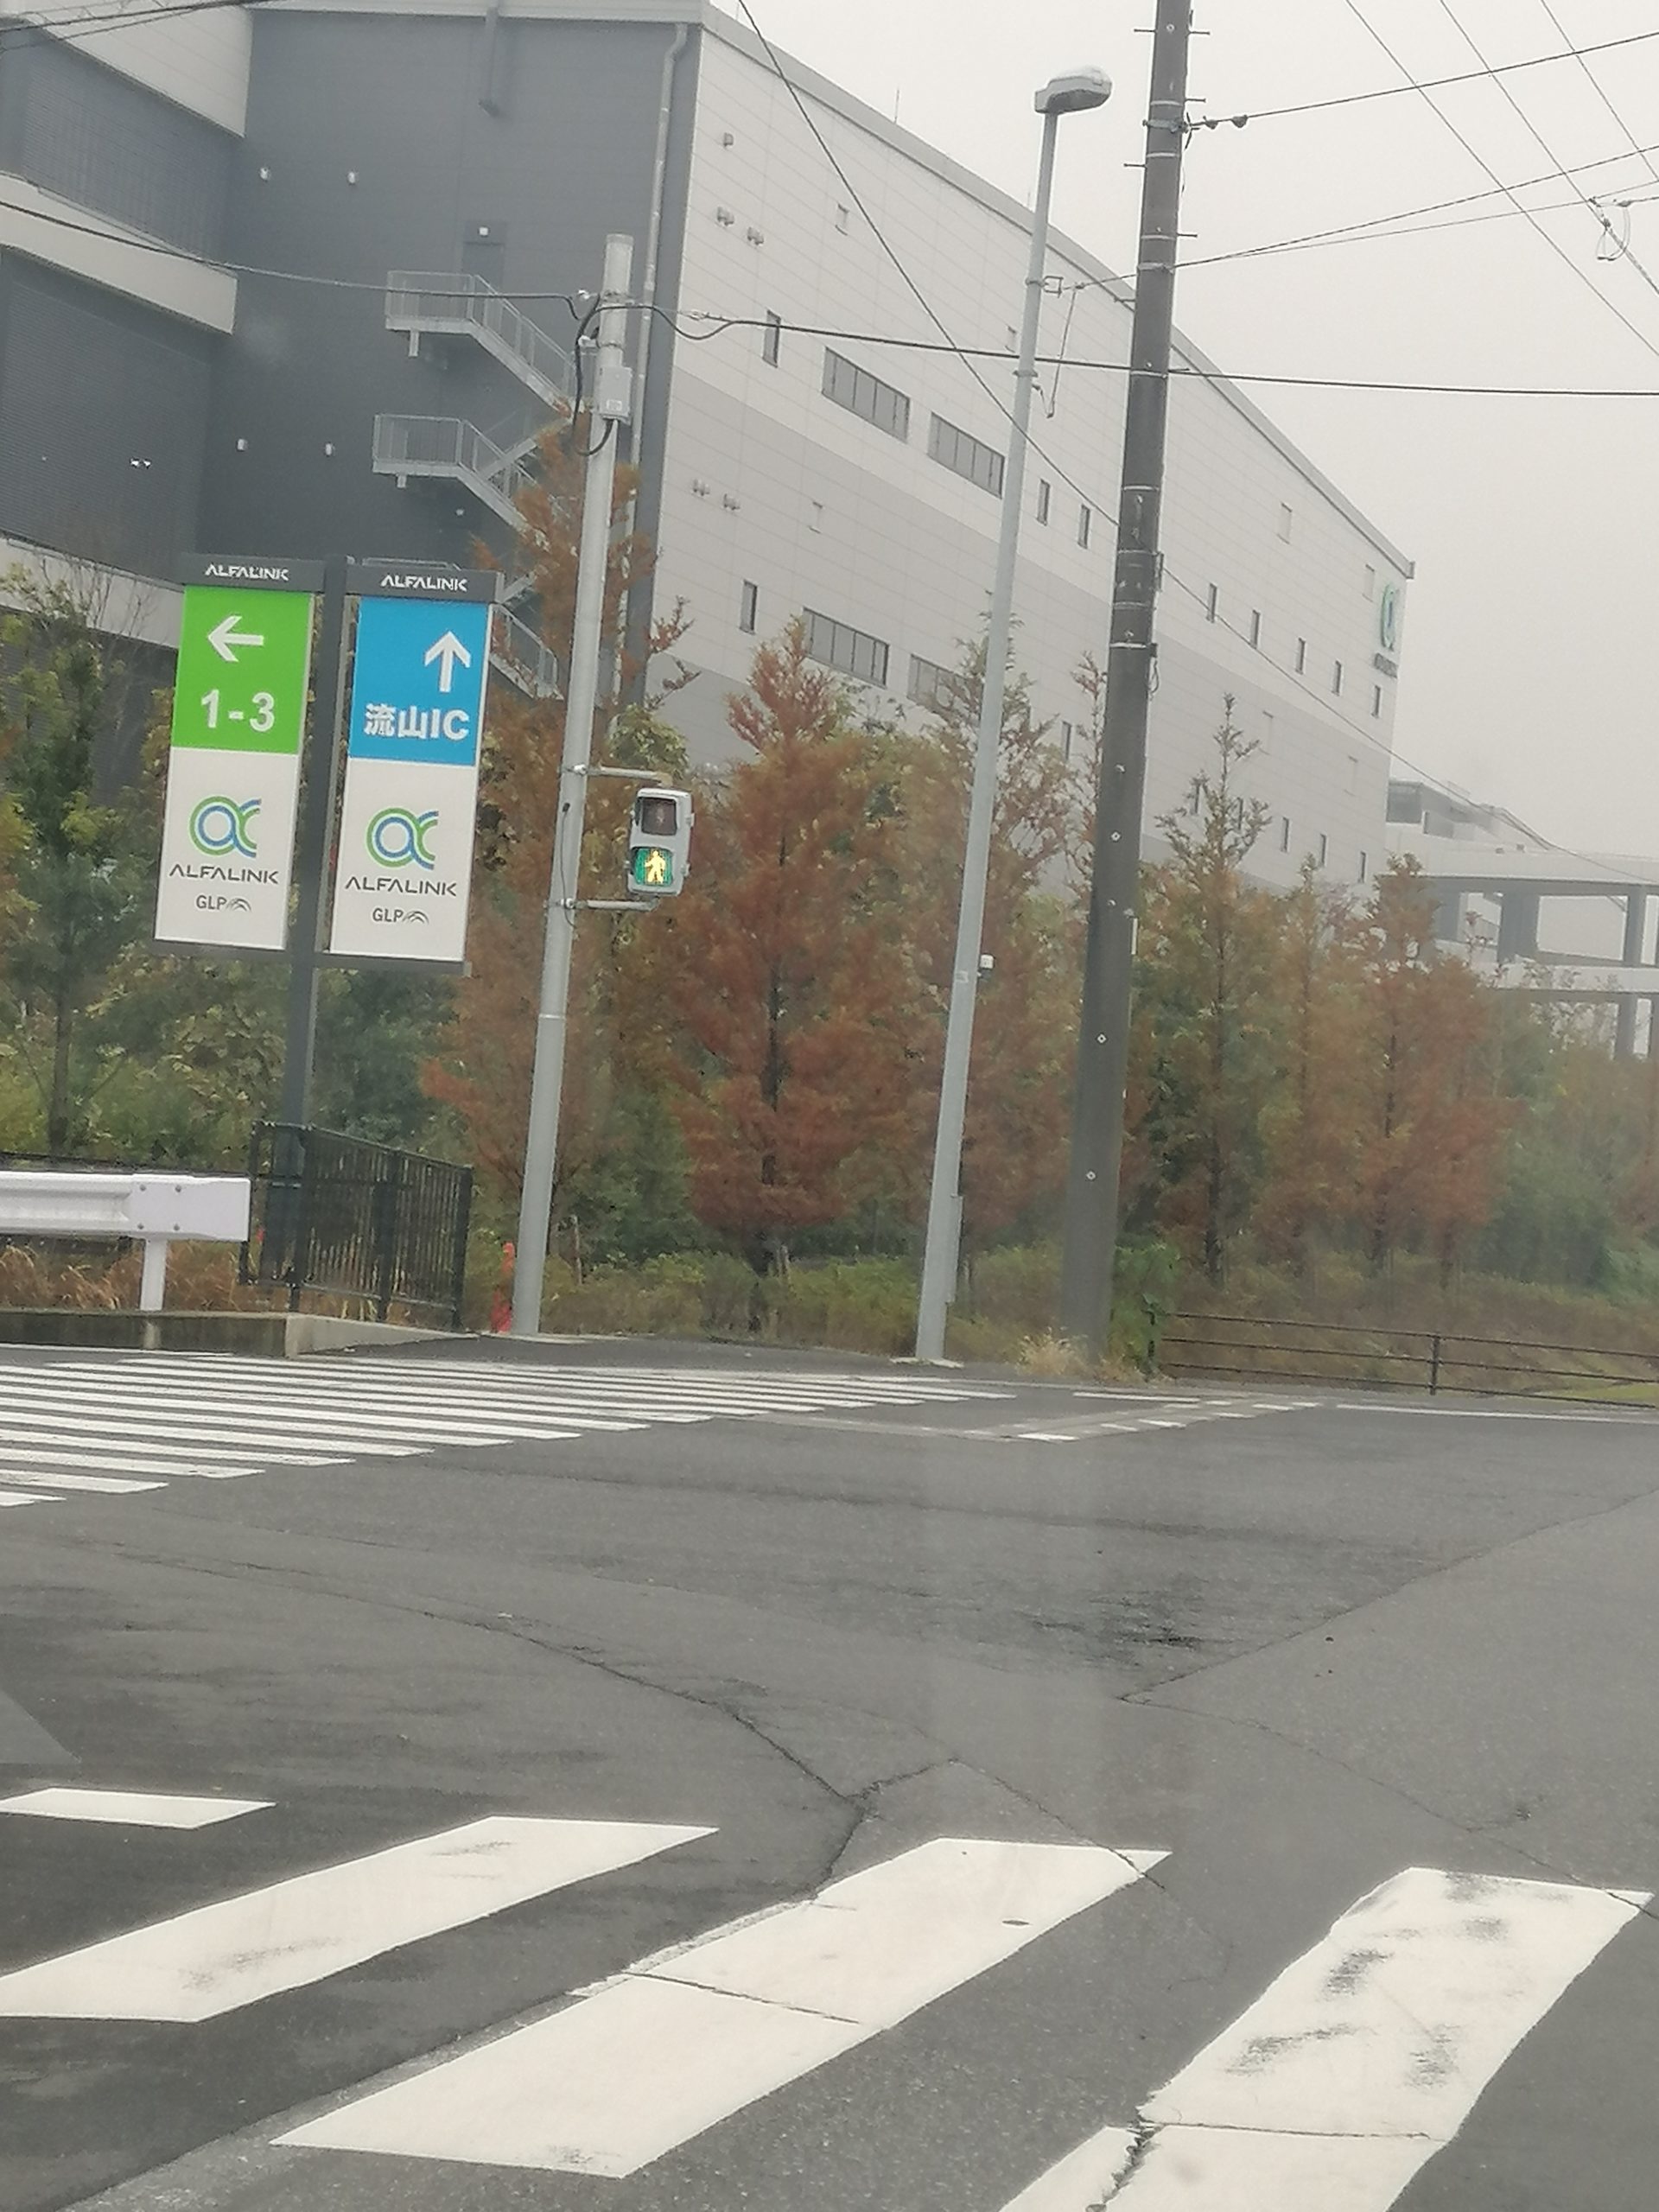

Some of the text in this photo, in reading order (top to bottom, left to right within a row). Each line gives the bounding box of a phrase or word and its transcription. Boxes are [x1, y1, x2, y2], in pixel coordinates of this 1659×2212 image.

[205, 563, 289, 582] ALFALINK
[380, 574, 467, 592] ALFALINK
[200, 690, 276, 732] 1-3
[364, 703, 469, 741] 流山IC
[168, 863, 279, 885] ALFALINK
[345, 875, 457, 897] ALFALINK
[195, 895, 227, 911] GLP
[372, 908, 404, 924] GLP
